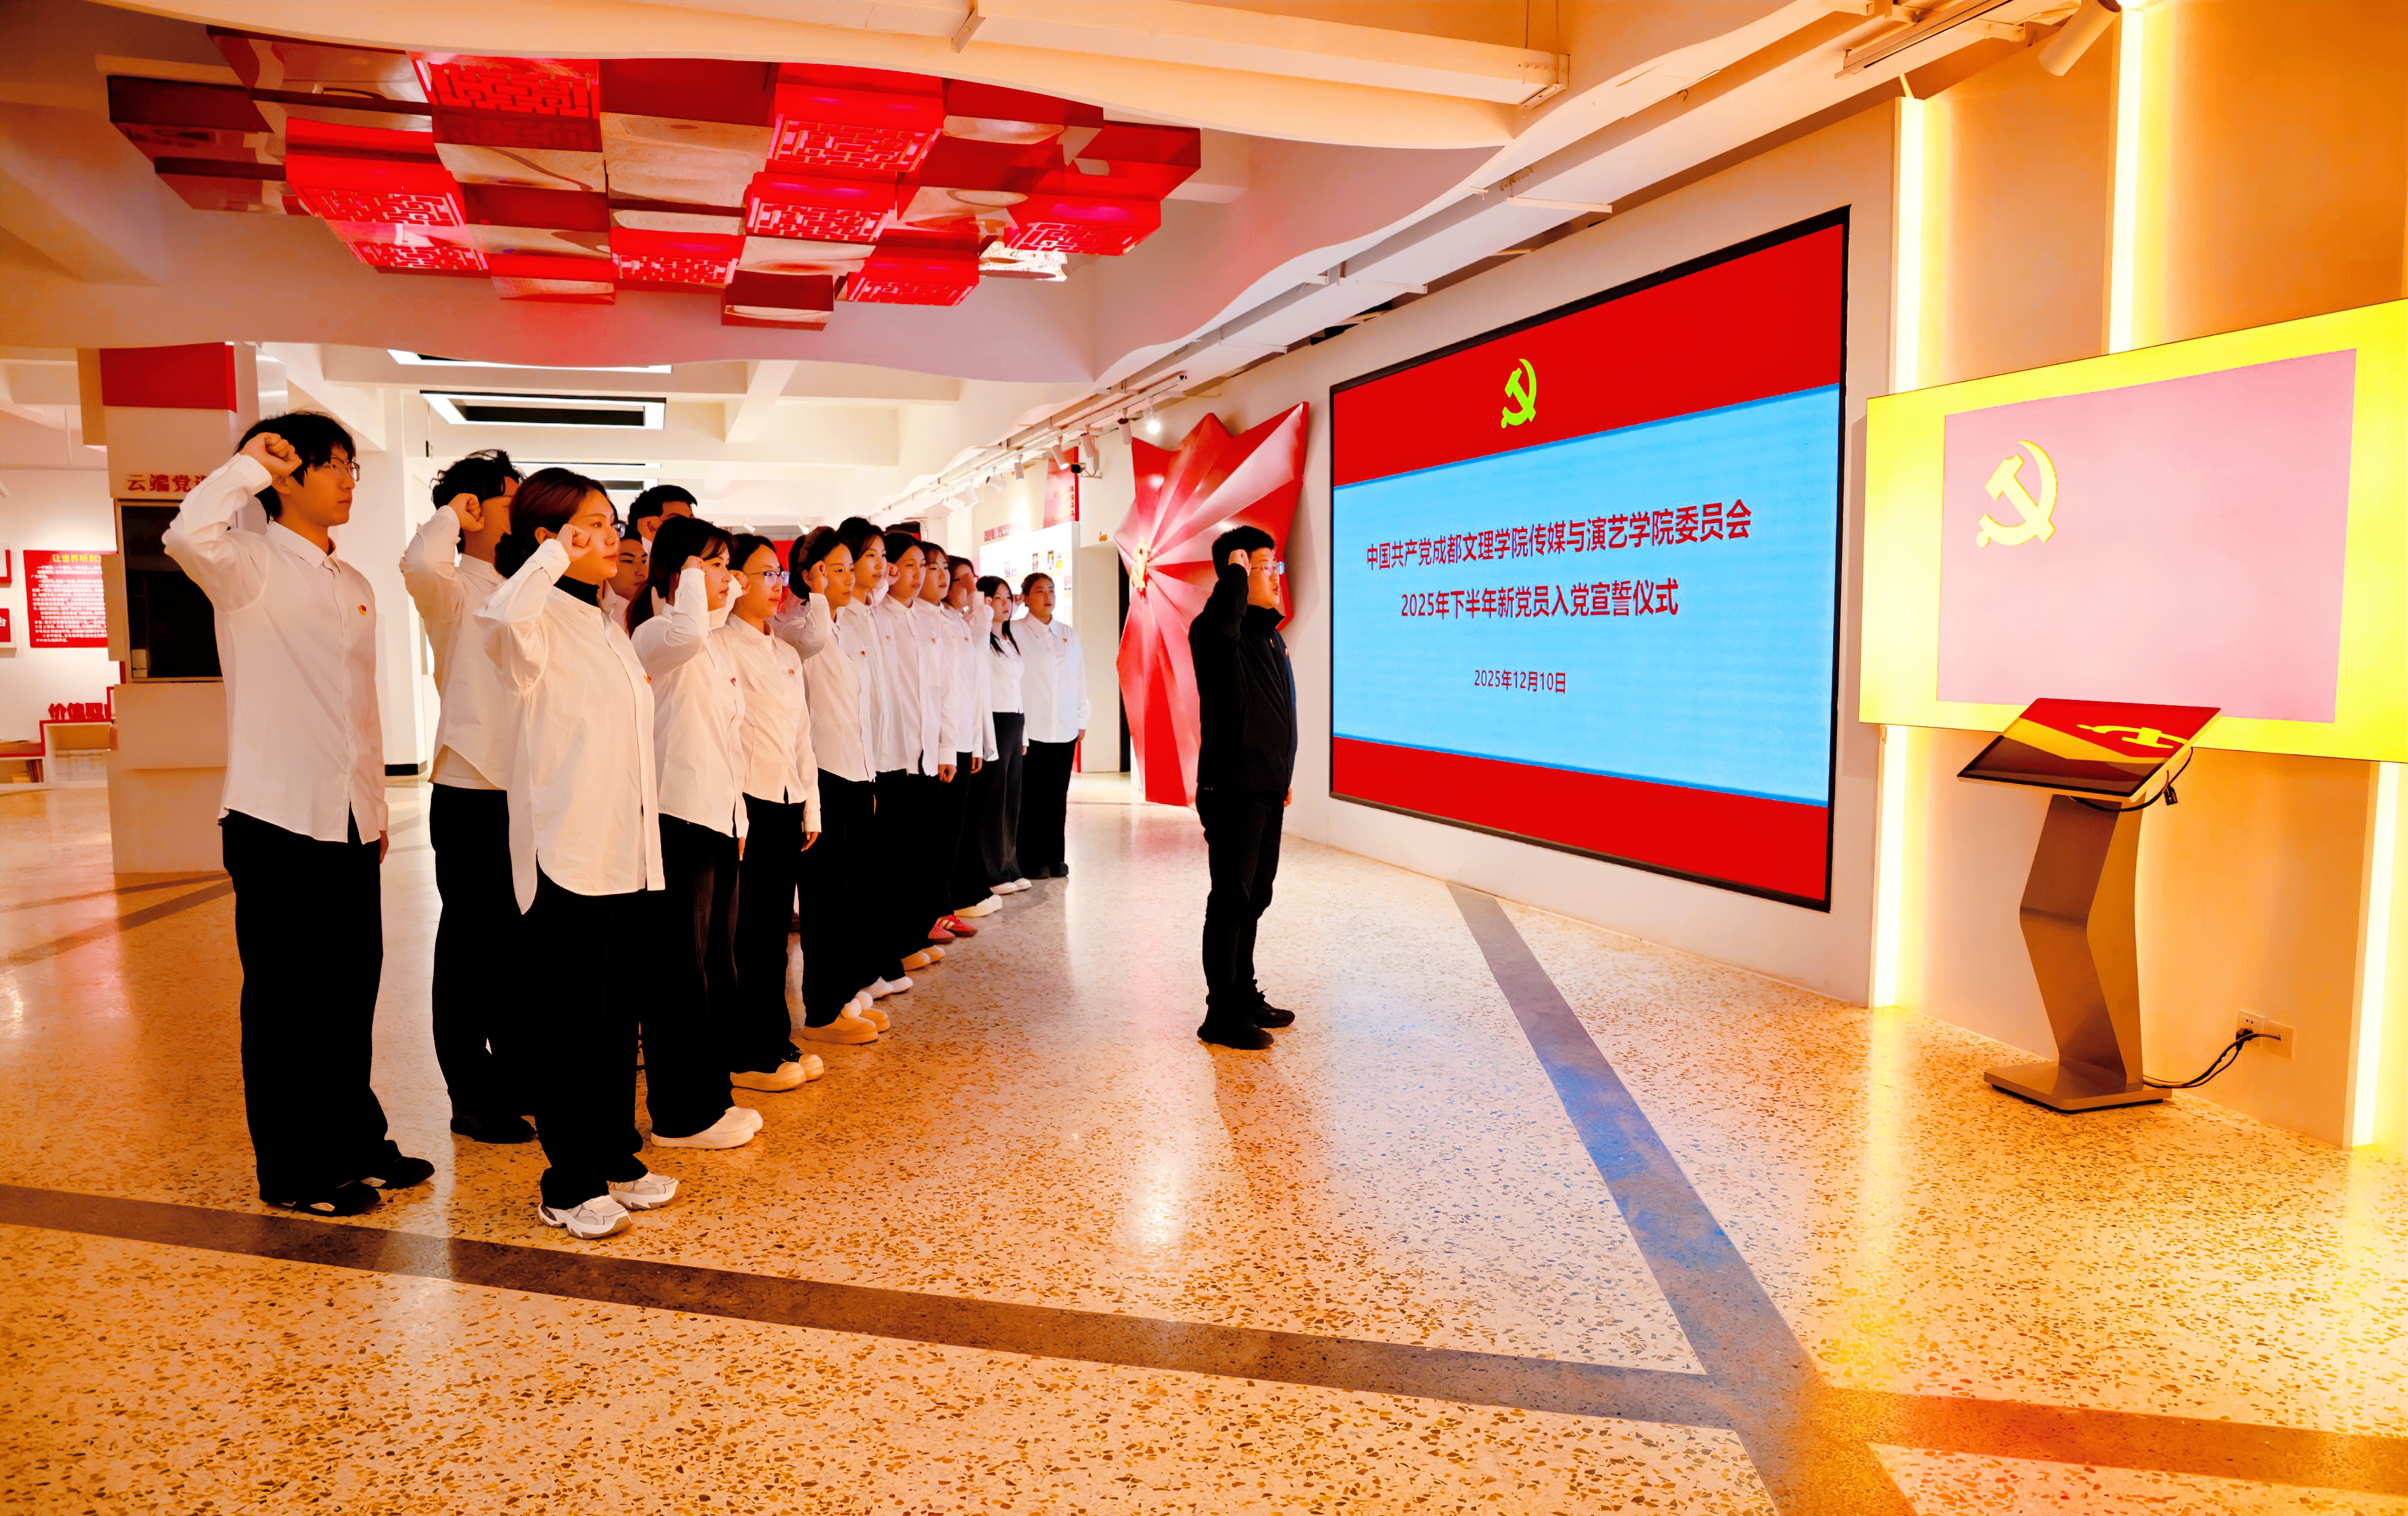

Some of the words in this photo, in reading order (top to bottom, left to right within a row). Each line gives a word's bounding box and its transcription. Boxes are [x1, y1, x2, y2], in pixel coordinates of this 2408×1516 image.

[1367, 499, 1752, 570] 中国共产党成都文理学院传媒与演艺学院委员会
[1401, 578, 1678, 619] 2025年下半年新党员入党宣誓仪式
[1475, 669, 1566, 694] 2025年12月10日
[48, 702, 107, 722] 价值取
